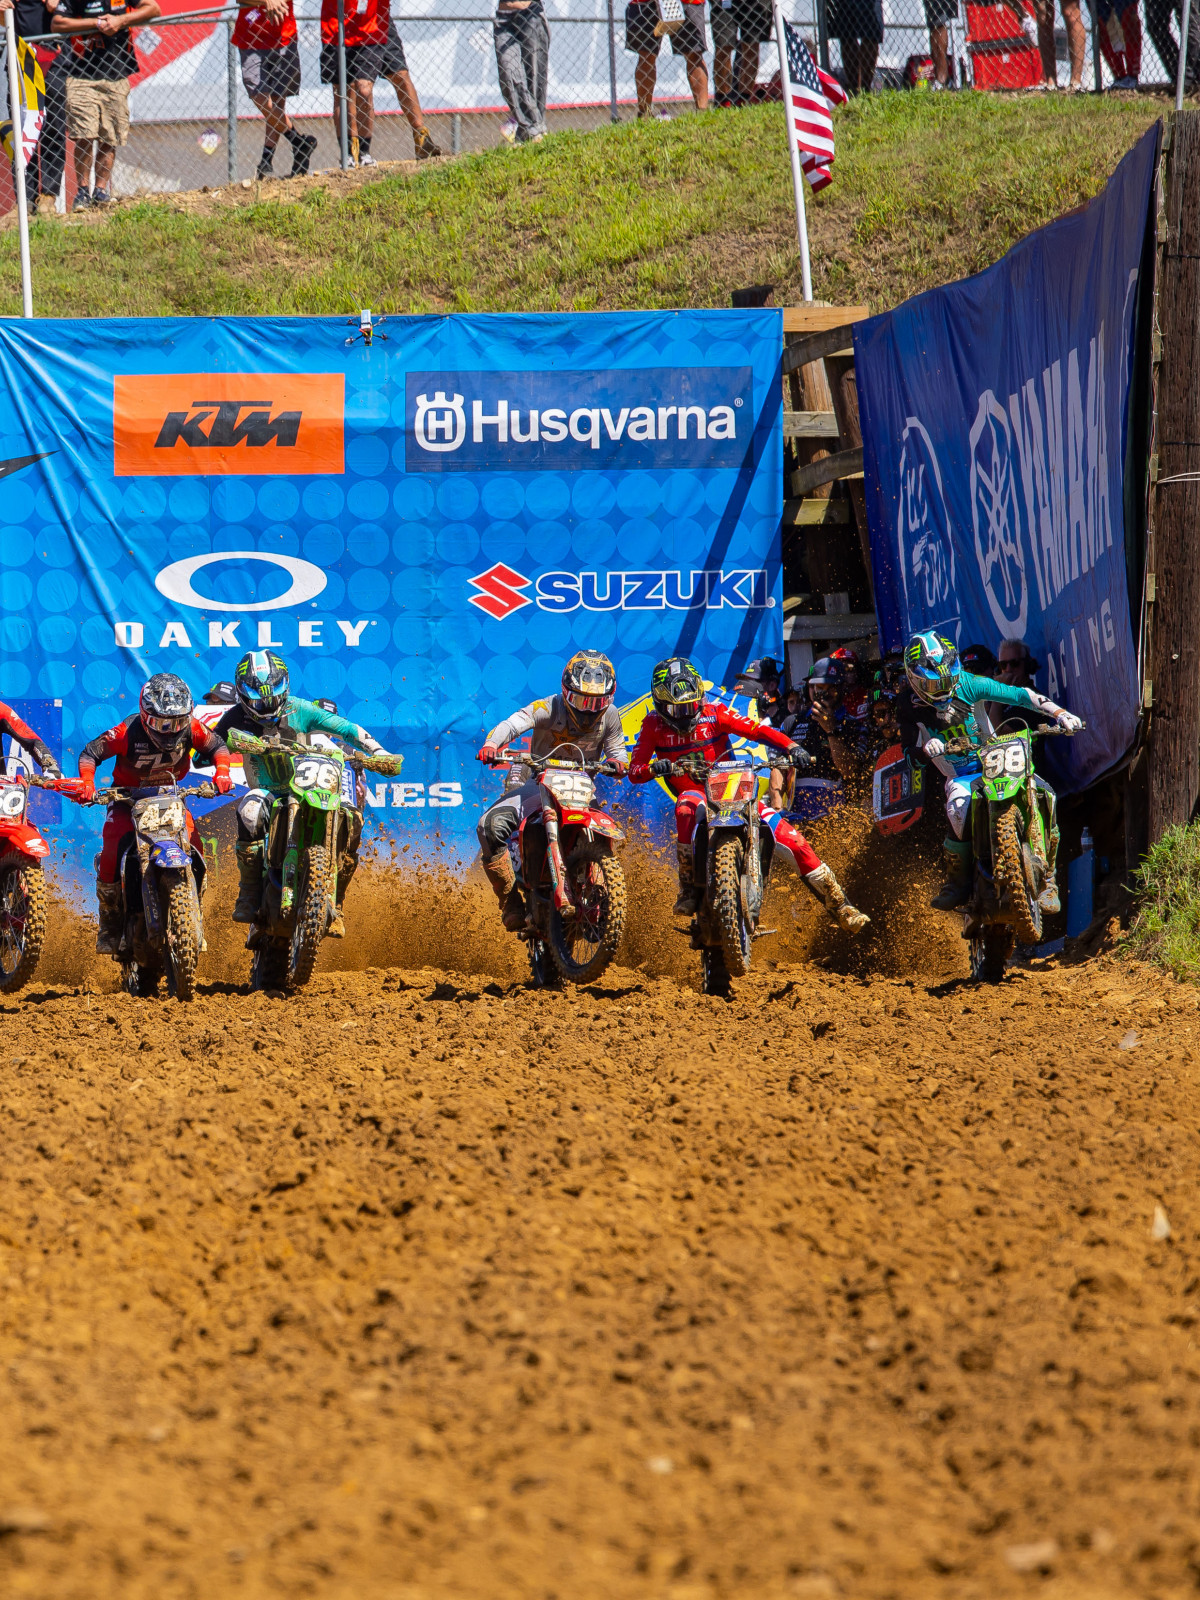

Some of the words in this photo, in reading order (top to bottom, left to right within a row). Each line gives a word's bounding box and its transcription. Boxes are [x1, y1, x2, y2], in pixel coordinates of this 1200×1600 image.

[154, 401, 302, 448] KTM
[472, 400, 737, 449] Husqvarna
[1008, 319, 1113, 611] YAMAHA
[536, 569, 768, 612] SUZUKI
[114, 620, 369, 648] OAKLEY
[294, 761, 338, 790] 36
[985, 746, 1025, 778] 98
[551, 775, 595, 800] 25
[721, 773, 743, 800] 1
[140, 802, 183, 832] 44
